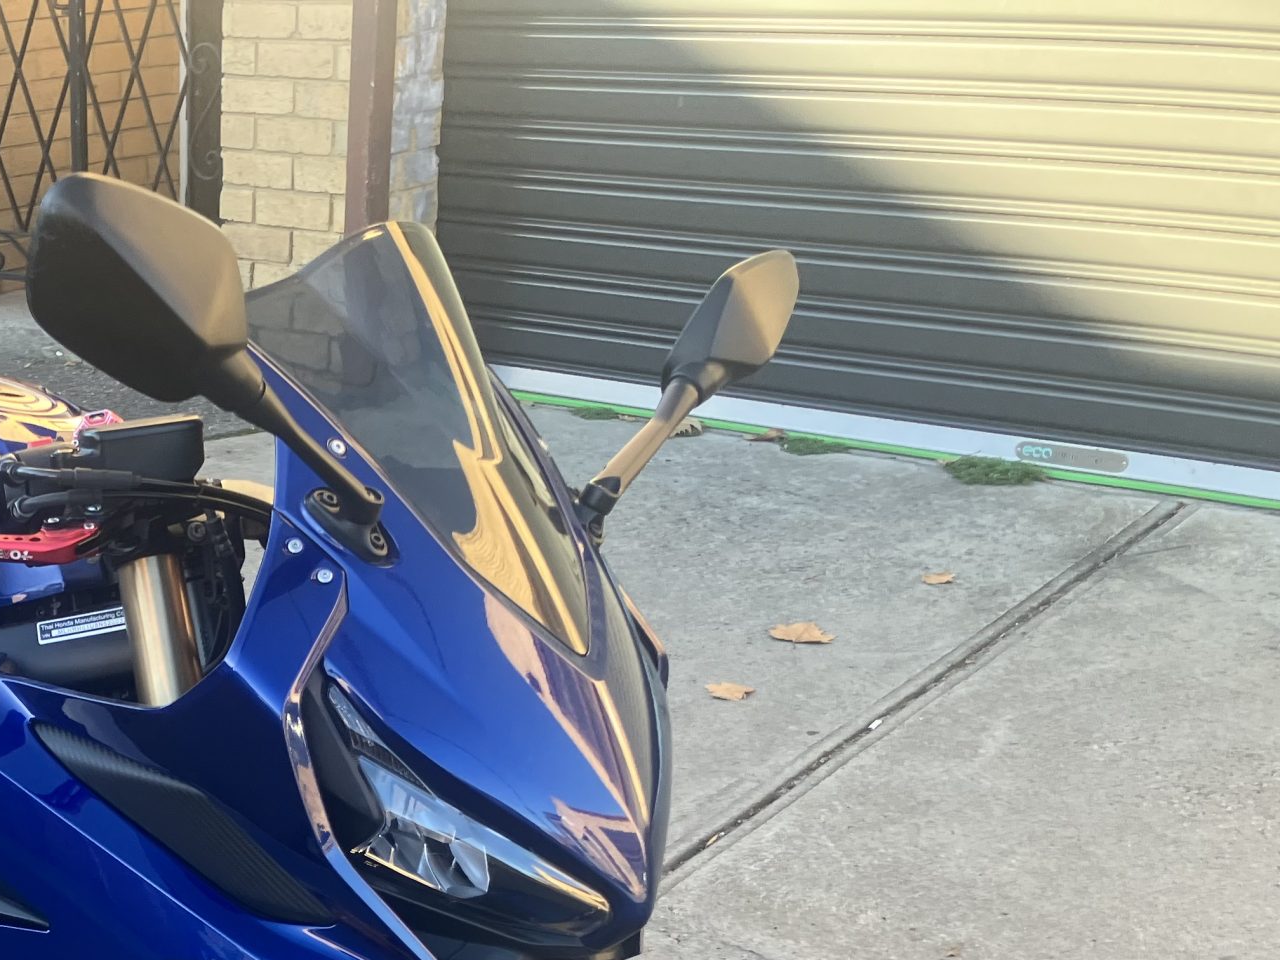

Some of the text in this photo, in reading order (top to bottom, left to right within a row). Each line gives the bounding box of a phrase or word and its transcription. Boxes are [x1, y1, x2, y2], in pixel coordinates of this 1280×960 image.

[1022, 445, 1053, 459] eco
[54, 621, 74, 629] Honda
[74, 613, 115, 625] Manufacturing
